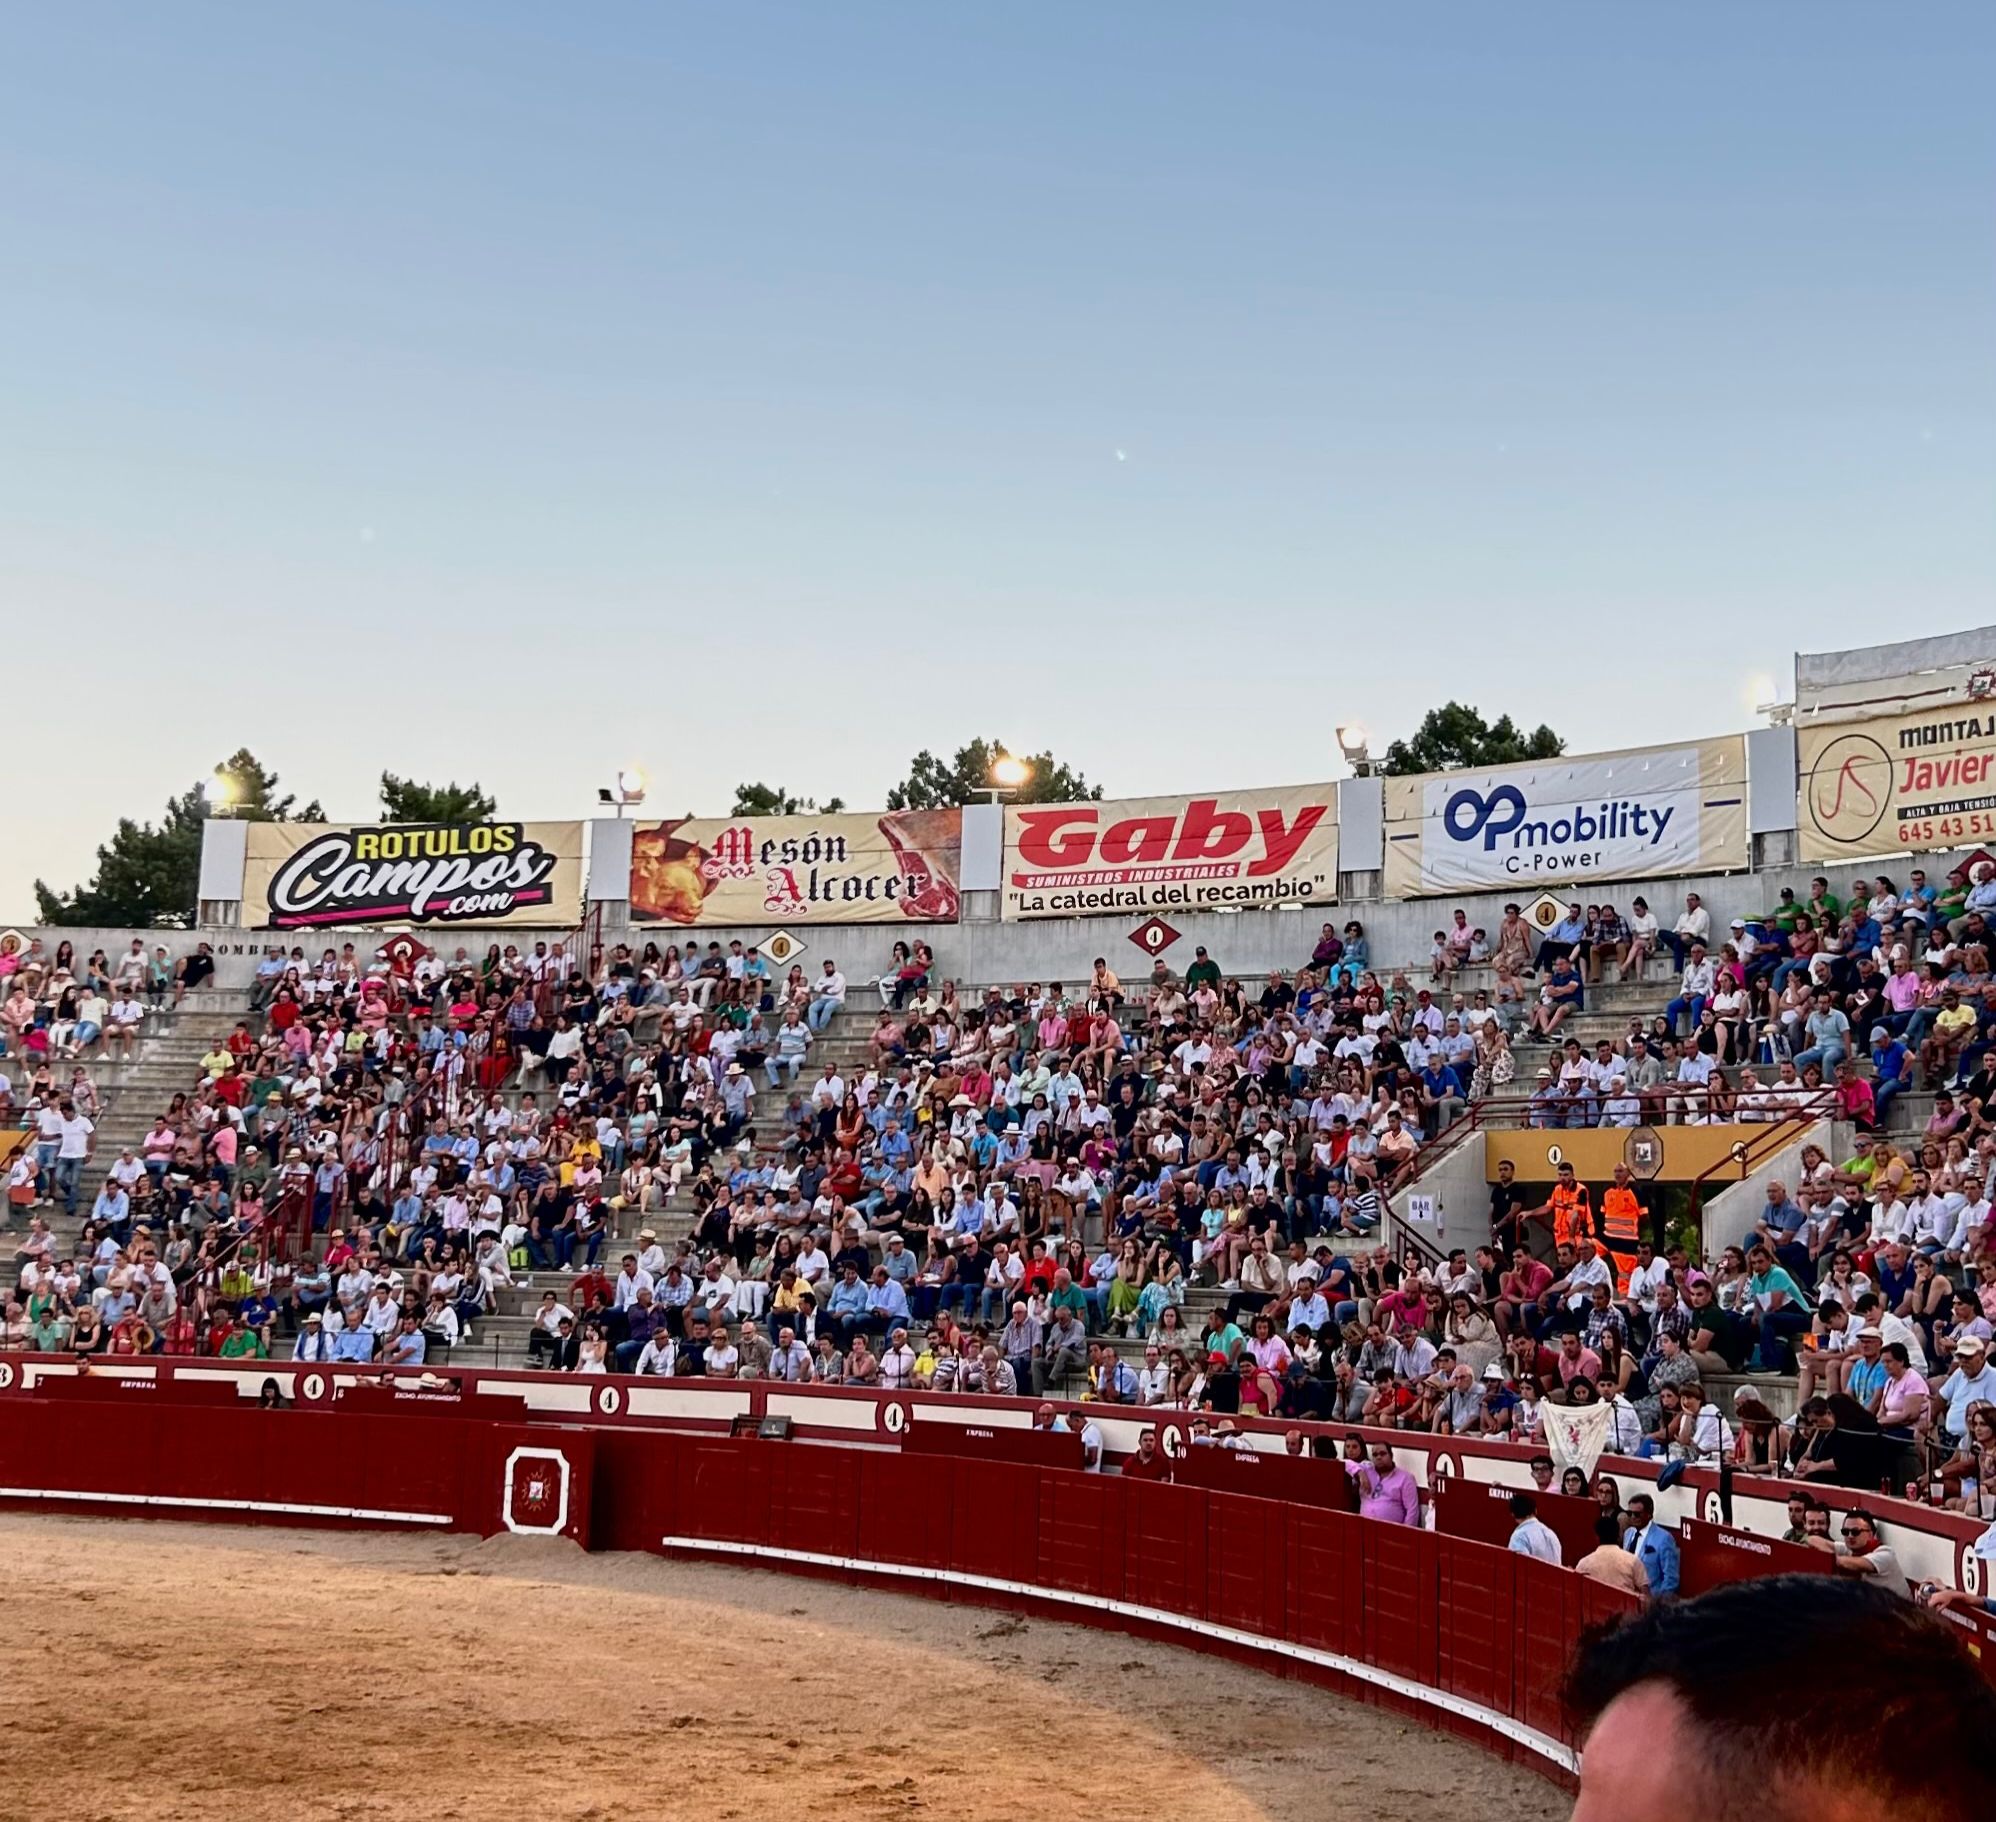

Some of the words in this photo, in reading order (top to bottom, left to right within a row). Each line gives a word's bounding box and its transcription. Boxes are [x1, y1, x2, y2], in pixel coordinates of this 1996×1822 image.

[1898, 749, 1995, 793] Javier
[1906, 807, 1926, 818] ALTA
[1929, 806, 1935, 816] Y
[1938, 802, 1960, 814] BAJA
[1017, 799, 1328, 877] Gaby
[1898, 821, 1933, 843] 645
[1940, 817, 1963, 837] 43
[1970, 814, 1994, 834] 51
[356, 825, 516, 860] ROTULOS
[702, 826, 849, 880] Mesón
[1506, 852, 1602, 873] C-Power
[274, 839, 549, 916] Campos
[1026, 870, 1123, 888] SUMINISTROS
[1128, 863, 1237, 883] INDUSTRIALES
[763, 867, 927, 915] Alcocer
[1050, 886, 1147, 909] catedral
[1152, 882, 1190, 905] del
[443, 892, 515, 915] .com
[776, 940, 786, 955] 4
[1149, 930, 1158, 943] 4
[1411, 1200, 1430, 1211] BAR
[36, 1376, 45, 1387] 7
[307, 1378, 318, 1396] 4
[604, 1391, 614, 1410] 4
[889, 1408, 899, 1428] 4
[1177, 1445, 1187, 1459] 10
[1437, 1479, 1446, 1494] 11
[1709, 1500, 1719, 1525] 5
[1682, 1523, 1692, 1540] 12
[1967, 1556, 1975, 1589] 5
